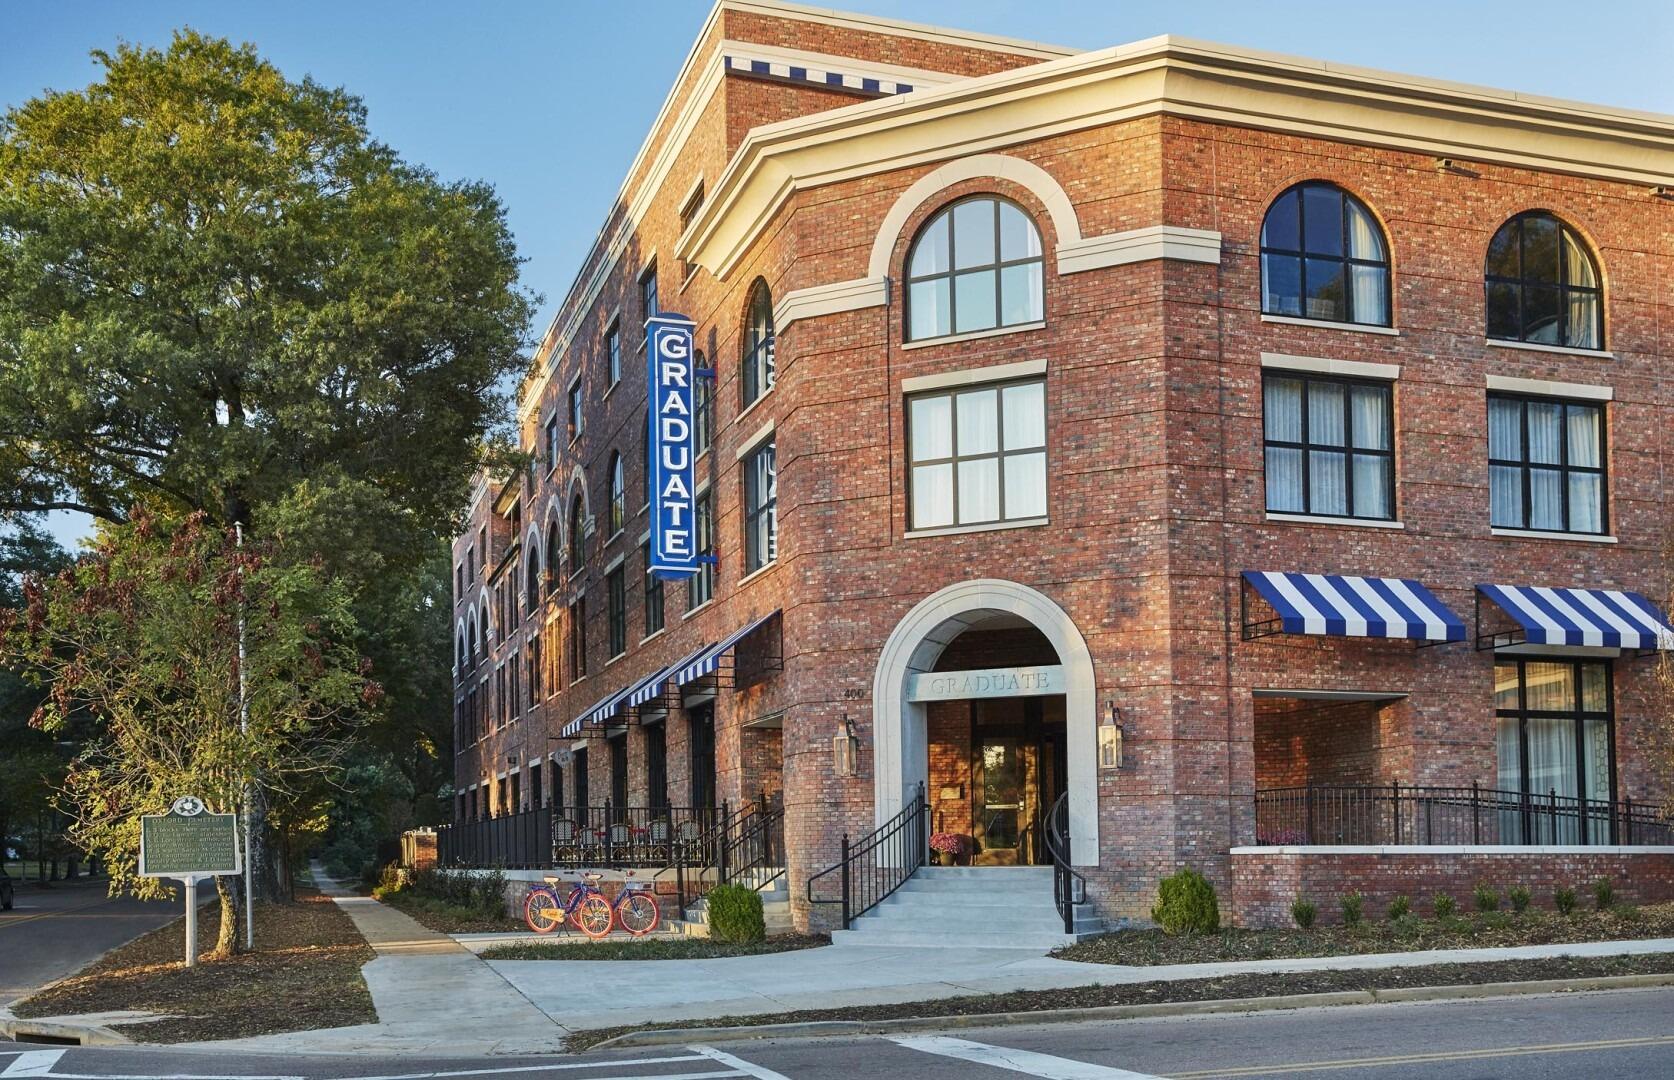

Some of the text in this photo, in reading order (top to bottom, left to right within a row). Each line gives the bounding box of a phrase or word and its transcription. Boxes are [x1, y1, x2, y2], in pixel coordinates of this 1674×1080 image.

[659, 334, 690, 556] GRADUATE
[844, 688, 864, 699] 400
[931, 672, 1050, 695] GRADUATE
